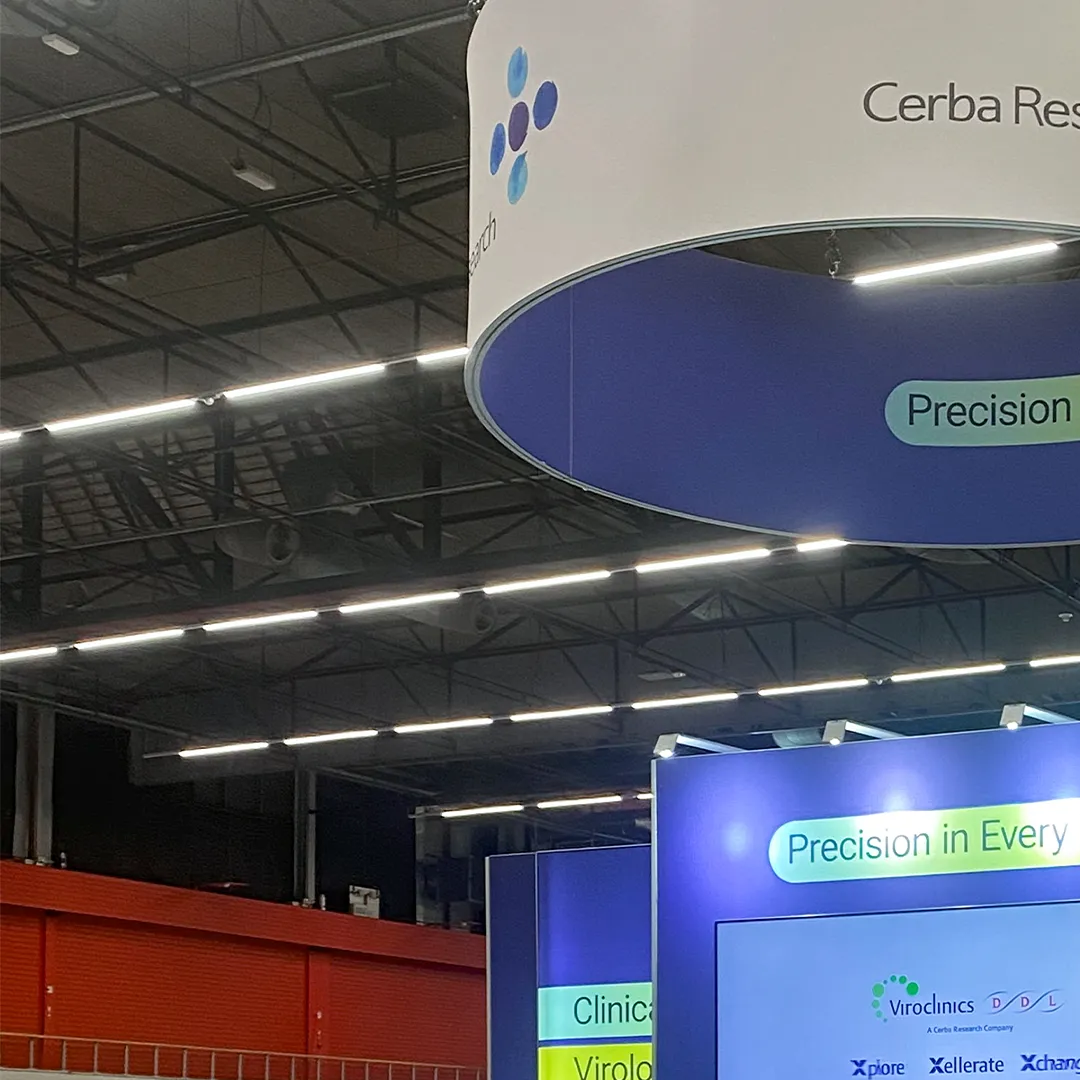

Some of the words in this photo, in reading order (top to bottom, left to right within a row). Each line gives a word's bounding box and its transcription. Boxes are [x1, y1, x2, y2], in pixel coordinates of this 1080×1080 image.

[863, 82, 1001, 123] Cerba
[908, 393, 1071, 427] Precision
[789, 828, 931, 864] Precision
[943, 822, 969, 854] in
[982, 819, 1069, 855] Every
[573, 994, 652, 1025] Clinic
[889, 993, 975, 1016] Viroclinics
[983, 1024, 1014, 1032] Company
[929, 1057, 1005, 1074] Xellerate
